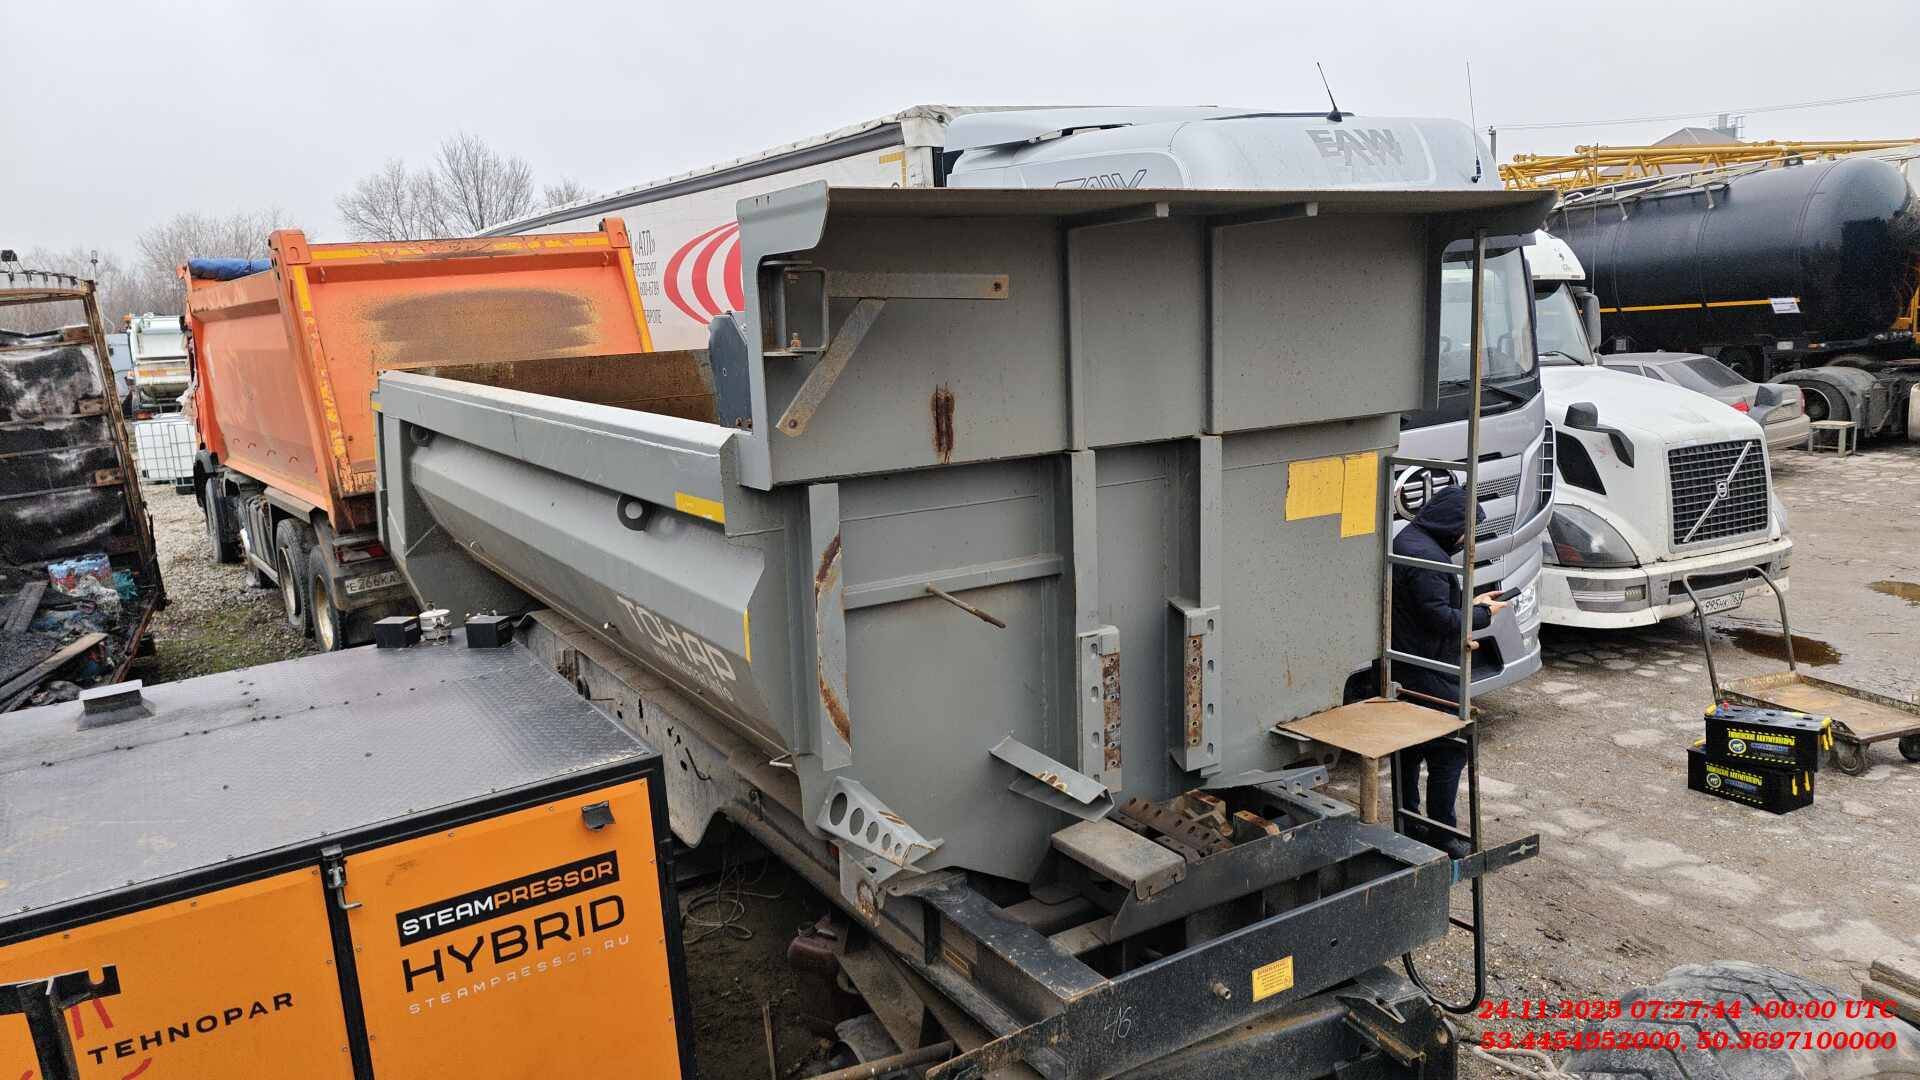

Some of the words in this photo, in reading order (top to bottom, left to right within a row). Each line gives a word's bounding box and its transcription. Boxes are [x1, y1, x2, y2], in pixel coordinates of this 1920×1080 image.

[402, 860, 613, 937] STEAMPRESSOR
[402, 894, 625, 993] HYBRID
[87, 992, 294, 1065] TEHNOPAR
